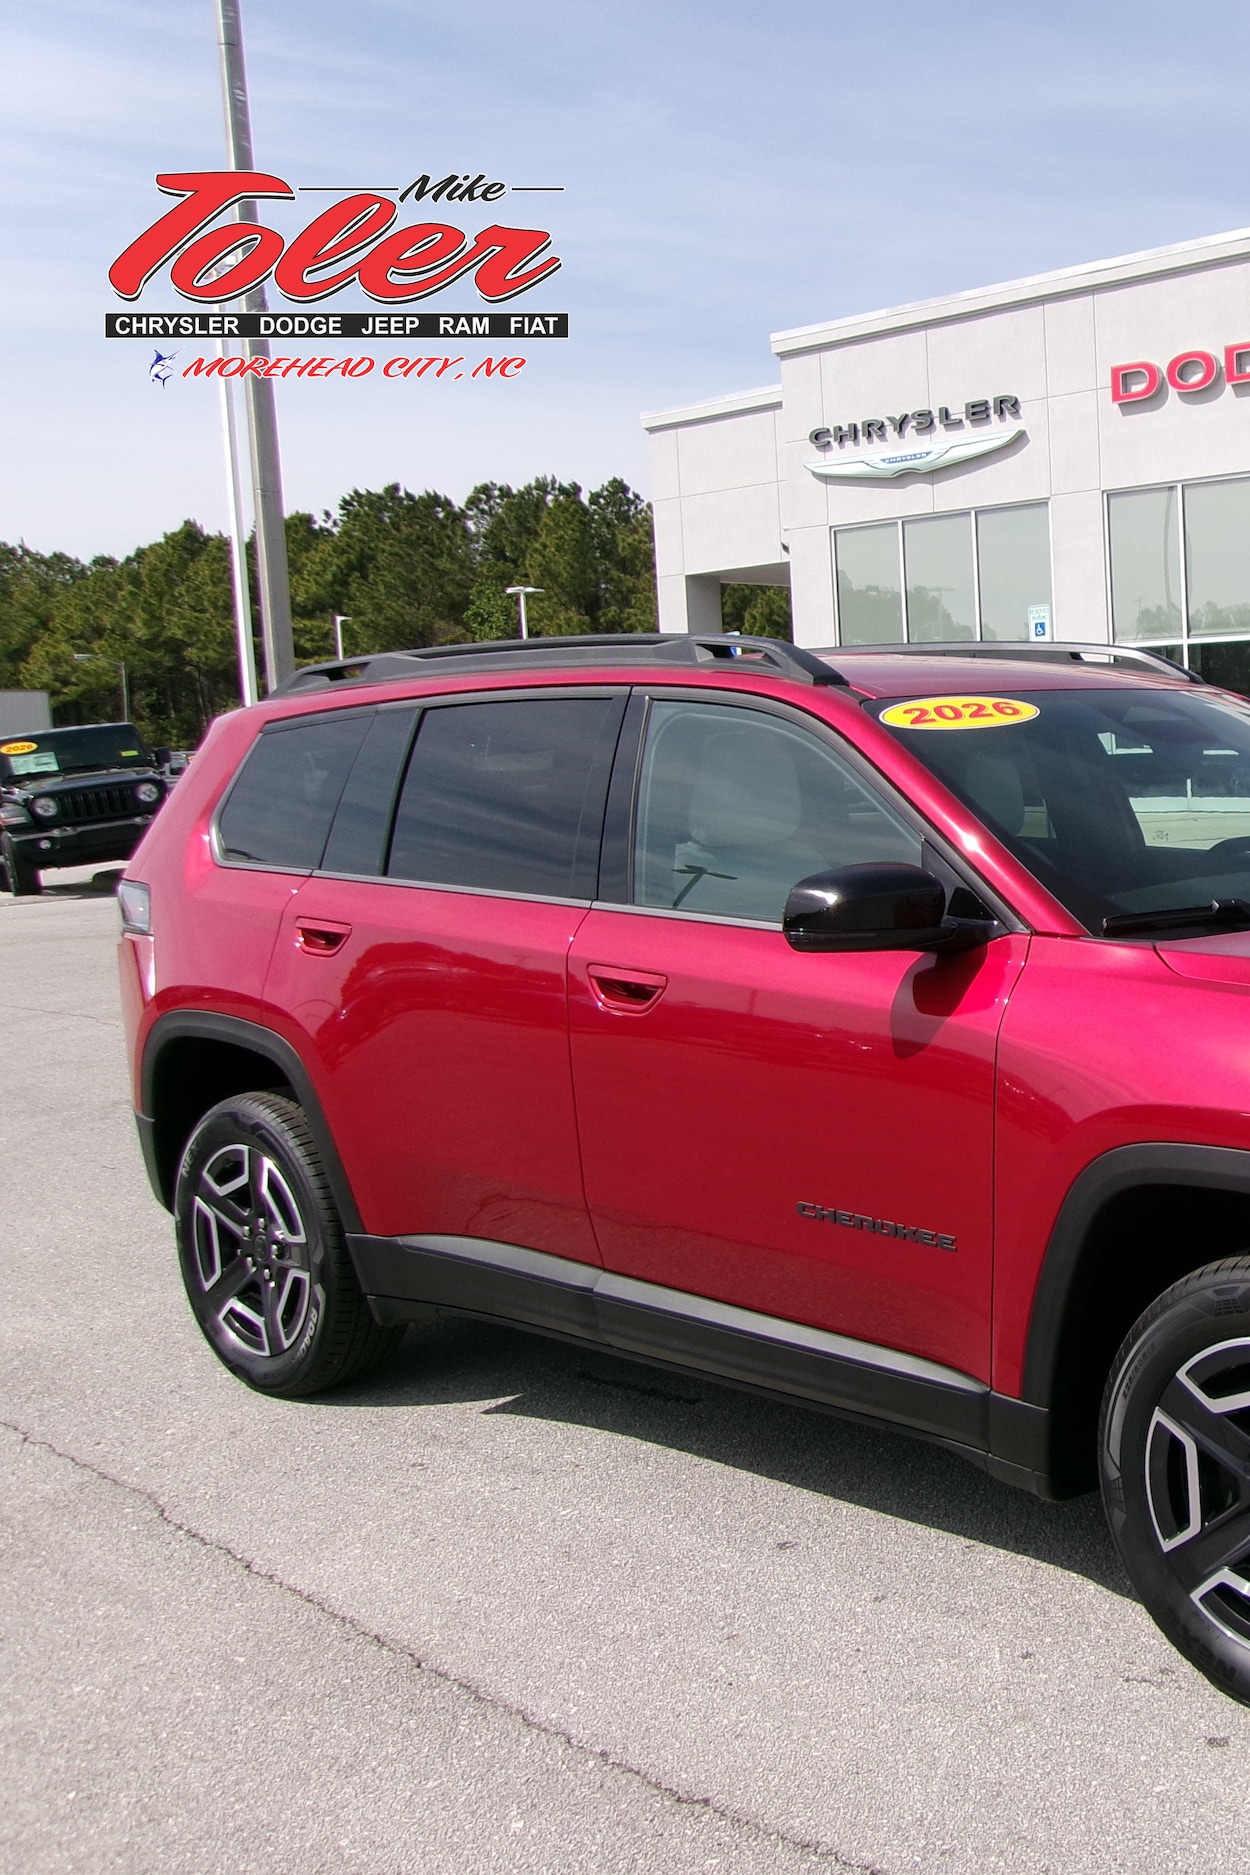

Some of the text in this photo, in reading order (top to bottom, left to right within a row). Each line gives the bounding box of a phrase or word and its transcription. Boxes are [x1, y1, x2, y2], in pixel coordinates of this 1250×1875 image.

[808, 395, 1020, 447] CHRYSLER
[903, 702, 1022, 725] 2026
[5, 744, 33, 752] 2026
[797, 1200, 957, 1252] CHEROKEE
